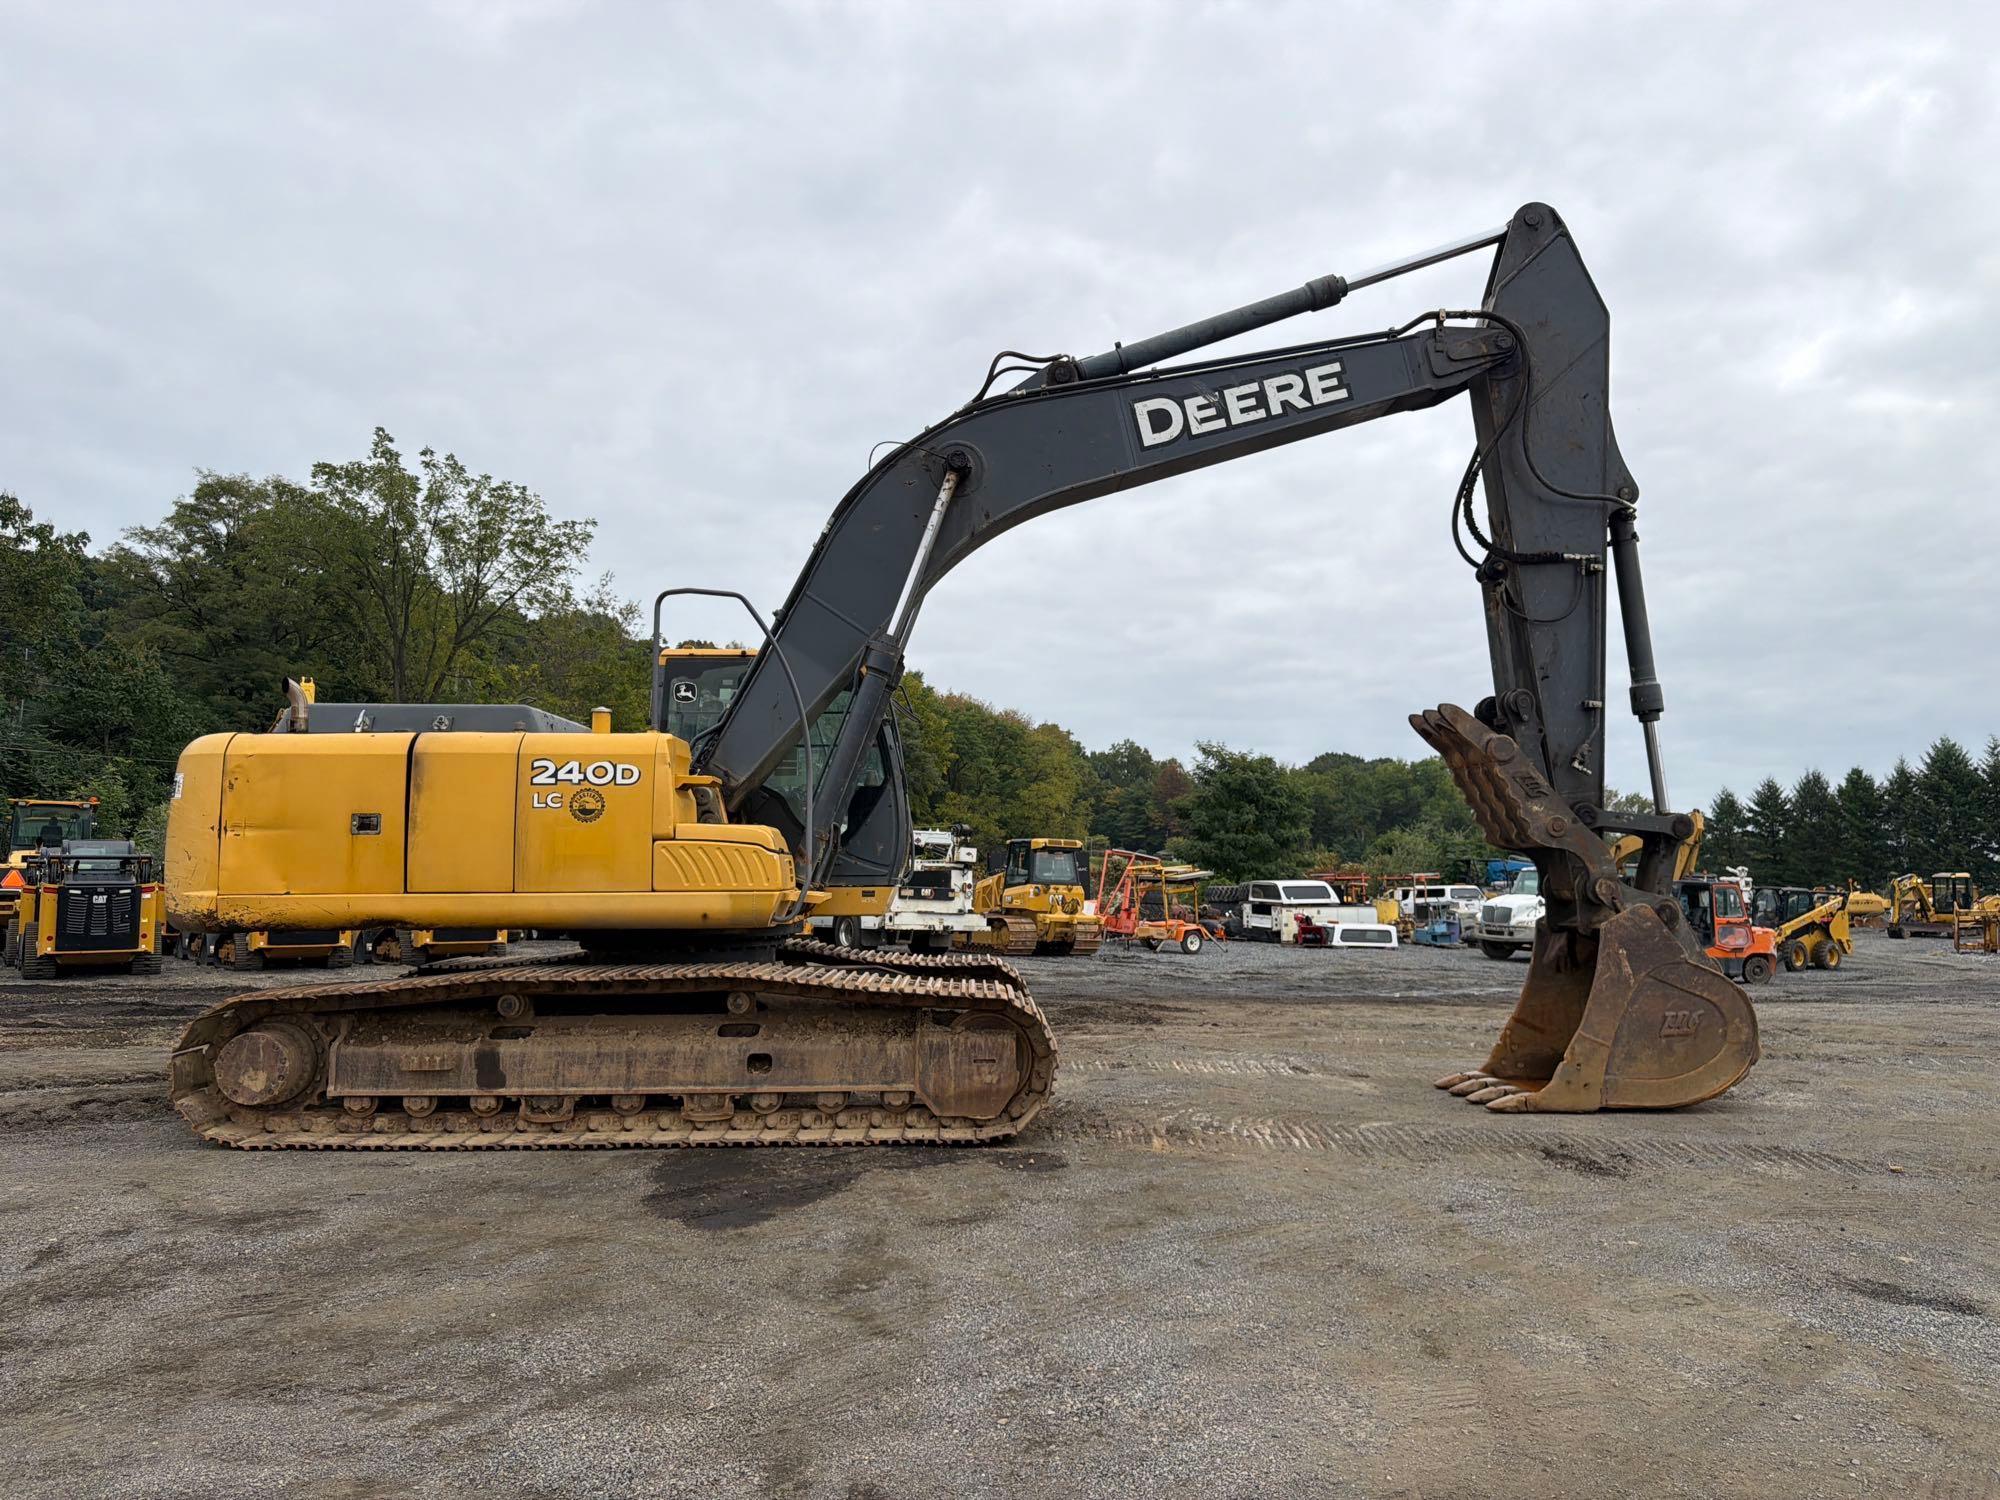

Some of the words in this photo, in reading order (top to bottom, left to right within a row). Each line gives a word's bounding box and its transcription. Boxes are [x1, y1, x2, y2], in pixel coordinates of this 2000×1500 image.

[1133, 361, 1349, 447] DEERE
[531, 758, 640, 785] 240D
[532, 792, 563, 808] LC
[93, 895, 107, 903] CAT
